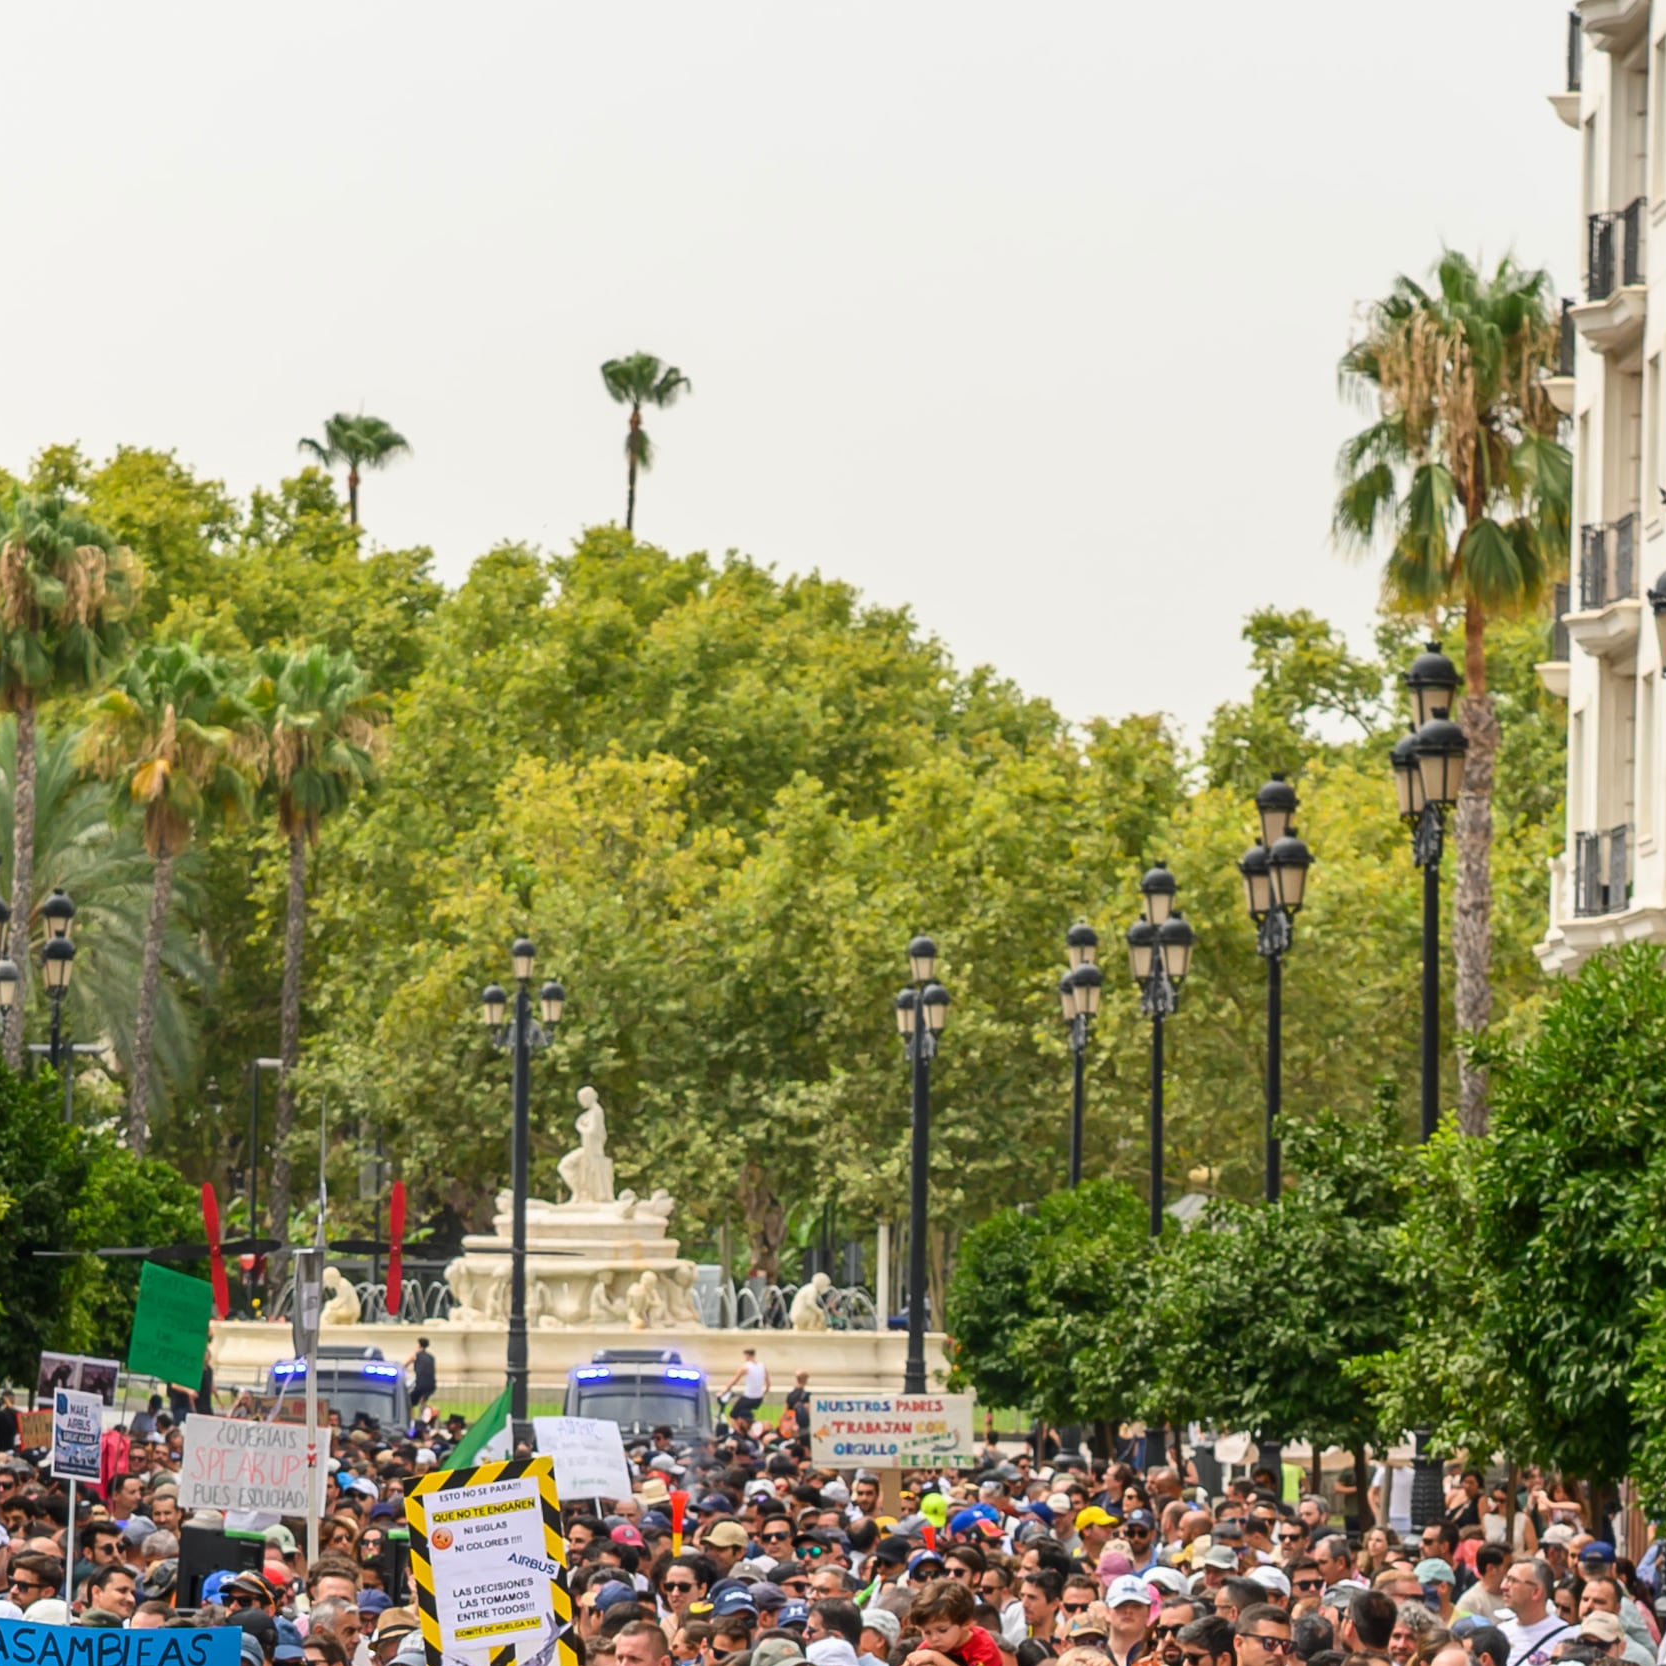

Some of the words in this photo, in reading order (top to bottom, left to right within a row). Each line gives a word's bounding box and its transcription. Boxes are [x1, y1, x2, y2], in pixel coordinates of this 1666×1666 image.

[816, 1400, 891, 1412] NUESTROS
[896, 1400, 944, 1412] PADRES
[831, 1421, 912, 1434] TRABAJAN
[833, 1442, 898, 1455] ORGULLO
[900, 1454, 975, 1467] RESPETO
[439, 1493, 460, 1502] ESTO
[463, 1490, 476, 1498] NO
[433, 1511, 454, 1522] QUE
[457, 1509, 471, 1518] NO
[474, 1506, 485, 1516] TE
[464, 1527, 473, 1535] NI
[475, 1521, 507, 1533] SIGLAS
[455, 1545, 464, 1553] NI
[466, 1538, 509, 1552] COLORES
[507, 1552, 557, 1575] AIRBUS
[453, 1587, 472, 1598] LAS
[474, 1577, 534, 1594] DECISIONES
[459, 1599, 478, 1609] LAS
[481, 1591, 530, 1605] TOMAMOS
[457, 1609, 490, 1622] ENTRE
